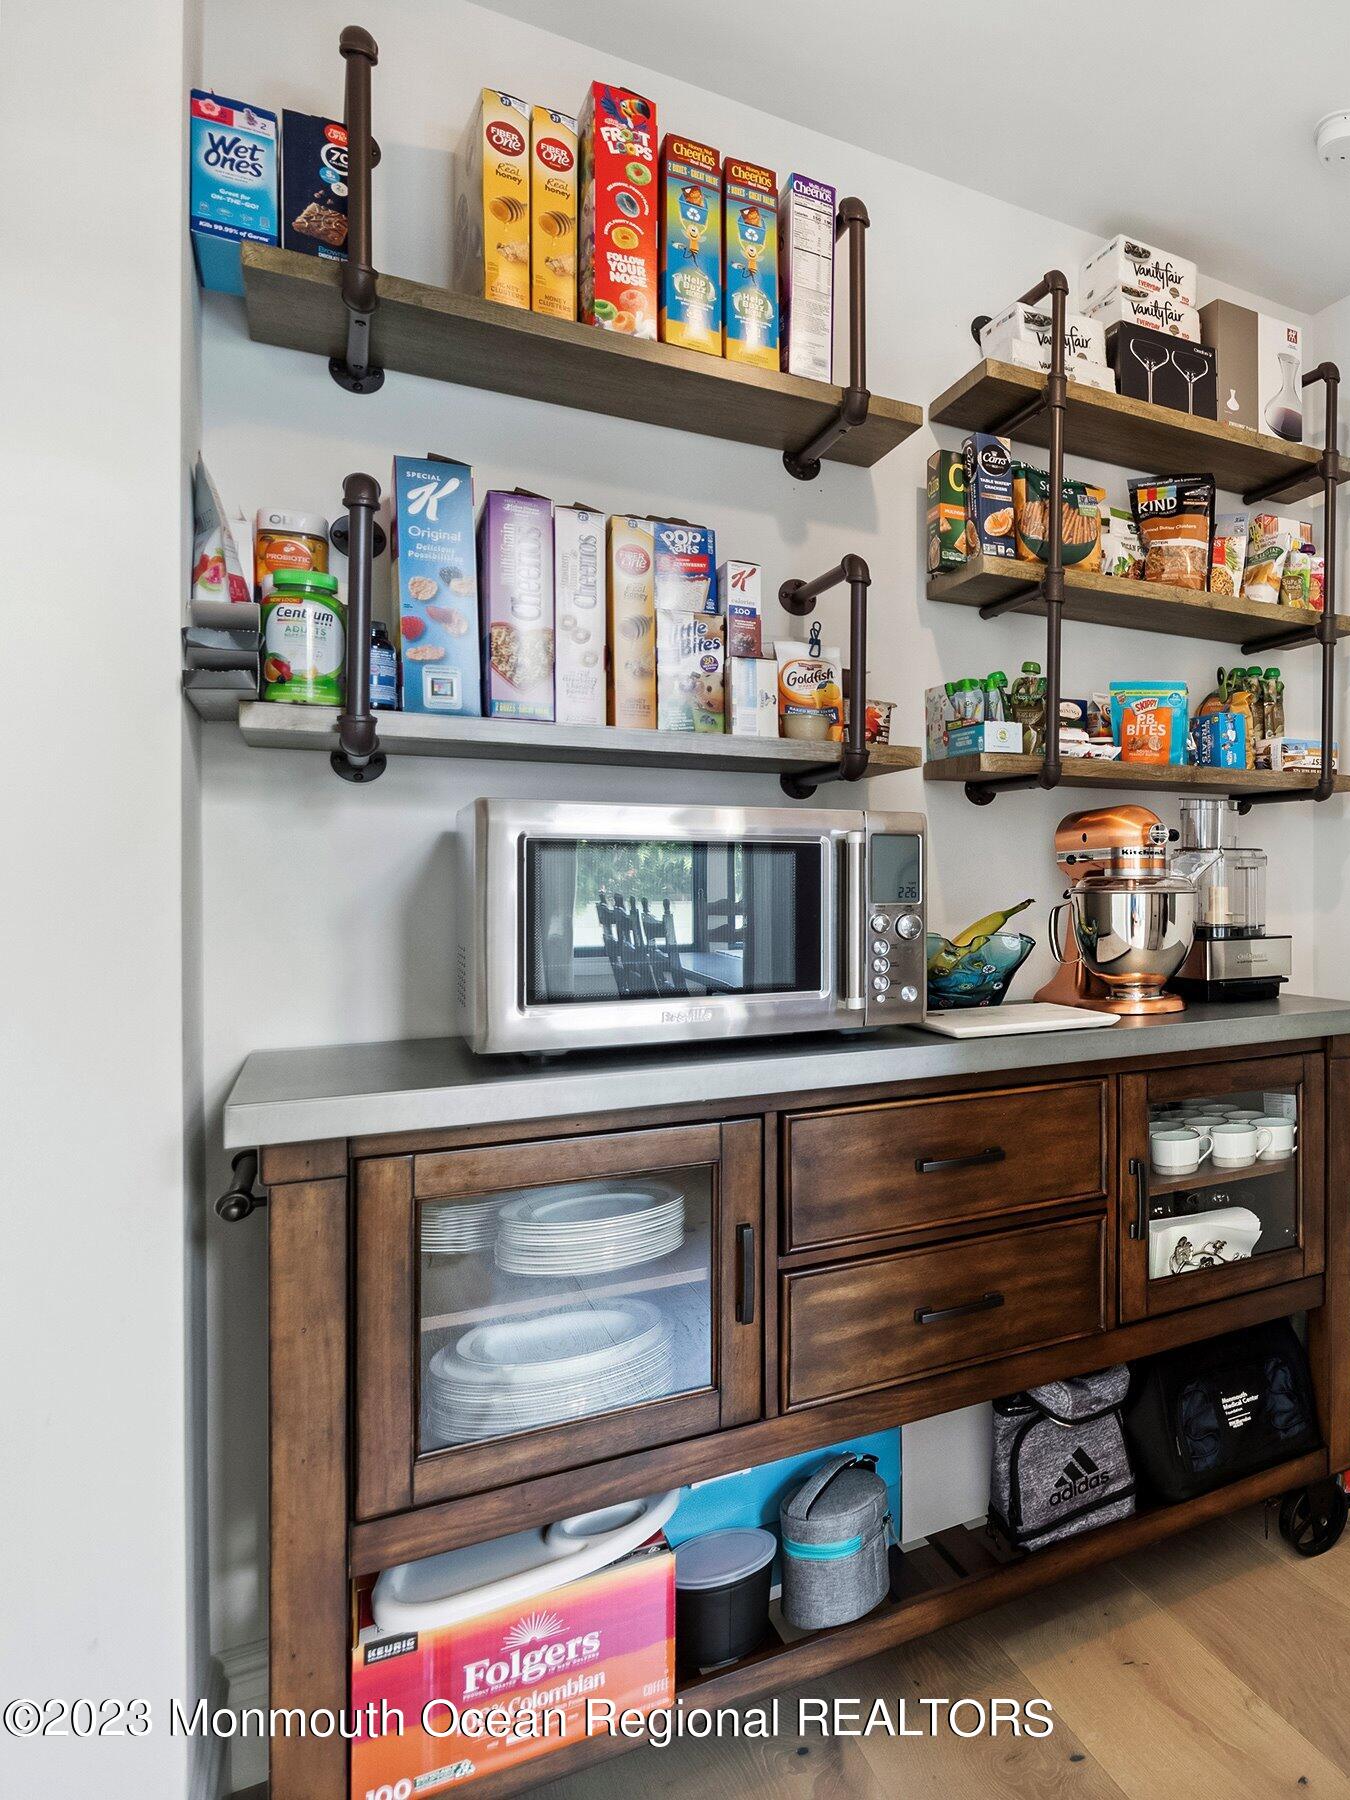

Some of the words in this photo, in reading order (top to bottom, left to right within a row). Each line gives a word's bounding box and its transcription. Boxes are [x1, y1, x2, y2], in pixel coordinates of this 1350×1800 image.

[490, 126, 519, 141] FIBER
[600, 126, 651, 147] FROOT
[208, 131, 265, 161] Wet
[492, 134, 521, 151] One
[540, 142, 567, 157] FIBER
[607, 140, 653, 161] LOOPS
[204, 148, 264, 177] Ones
[542, 150, 570, 166] One
[673, 142, 715, 167] Cheerios
[495, 169, 523, 186] honey
[497, 162, 520, 177] Real
[731, 165, 772, 188] Cheerios
[544, 184, 571, 200] honey
[547, 177, 569, 191] Real
[793, 180, 832, 203] Cheerios
[219, 188, 239, 199] Great
[199, 220, 213, 229] Kills
[247, 232, 269, 243] Germs
[606, 251, 646, 267] FOLLOW
[607, 260, 647, 278] YOUR
[609, 270, 648, 288] NOSE
[683, 273, 706, 288] Help
[1137, 279, 1161, 293] EVERYDAY
[742, 293, 764, 306] Help
[1136, 317, 1161, 330] EVERYDAY
[982, 453, 1007, 466] Carr's
[406, 471, 442, 482] SPECIAL
[980, 477, 994, 485] TABLE
[984, 484, 1008, 492] CRACKERS
[1039, 480, 1074, 495] Stks
[407, 477, 461, 522] K
[1138, 497, 1177, 514] KIND
[408, 525, 461, 542] Original
[416, 542, 455, 554] Delicious
[266, 553, 311, 564] PROBIOTIC
[511, 527, 541, 619] Cheerios
[574, 534, 598, 609] Cheerios
[731, 567, 757, 592] K
[276, 606, 334, 623] Centum
[734, 607, 751, 616] 100
[284, 624, 328, 637] ADUTS
[786, 668, 834, 687] Goldfish
[1134, 698, 1158, 712] SKIPPY
[1137, 713, 1158, 724] P.B.
[1126, 724, 1167, 736] BITES
[1222, 1399, 1243, 1410] Medical
[1242, 1394, 1259, 1404] Center
[1049, 1471, 1110, 1506] adidas
[367, 1637, 416, 1660] KEURIG
[463, 1630, 601, 1693] Folgers
[463, 1688, 489, 1701] PROUDLY
[490, 1679, 517, 1692] ROASTED
[557, 1661, 572, 1671] NEW
[643, 1676, 669, 1697] COFFEE
[506, 1670, 606, 1714] Colombian
